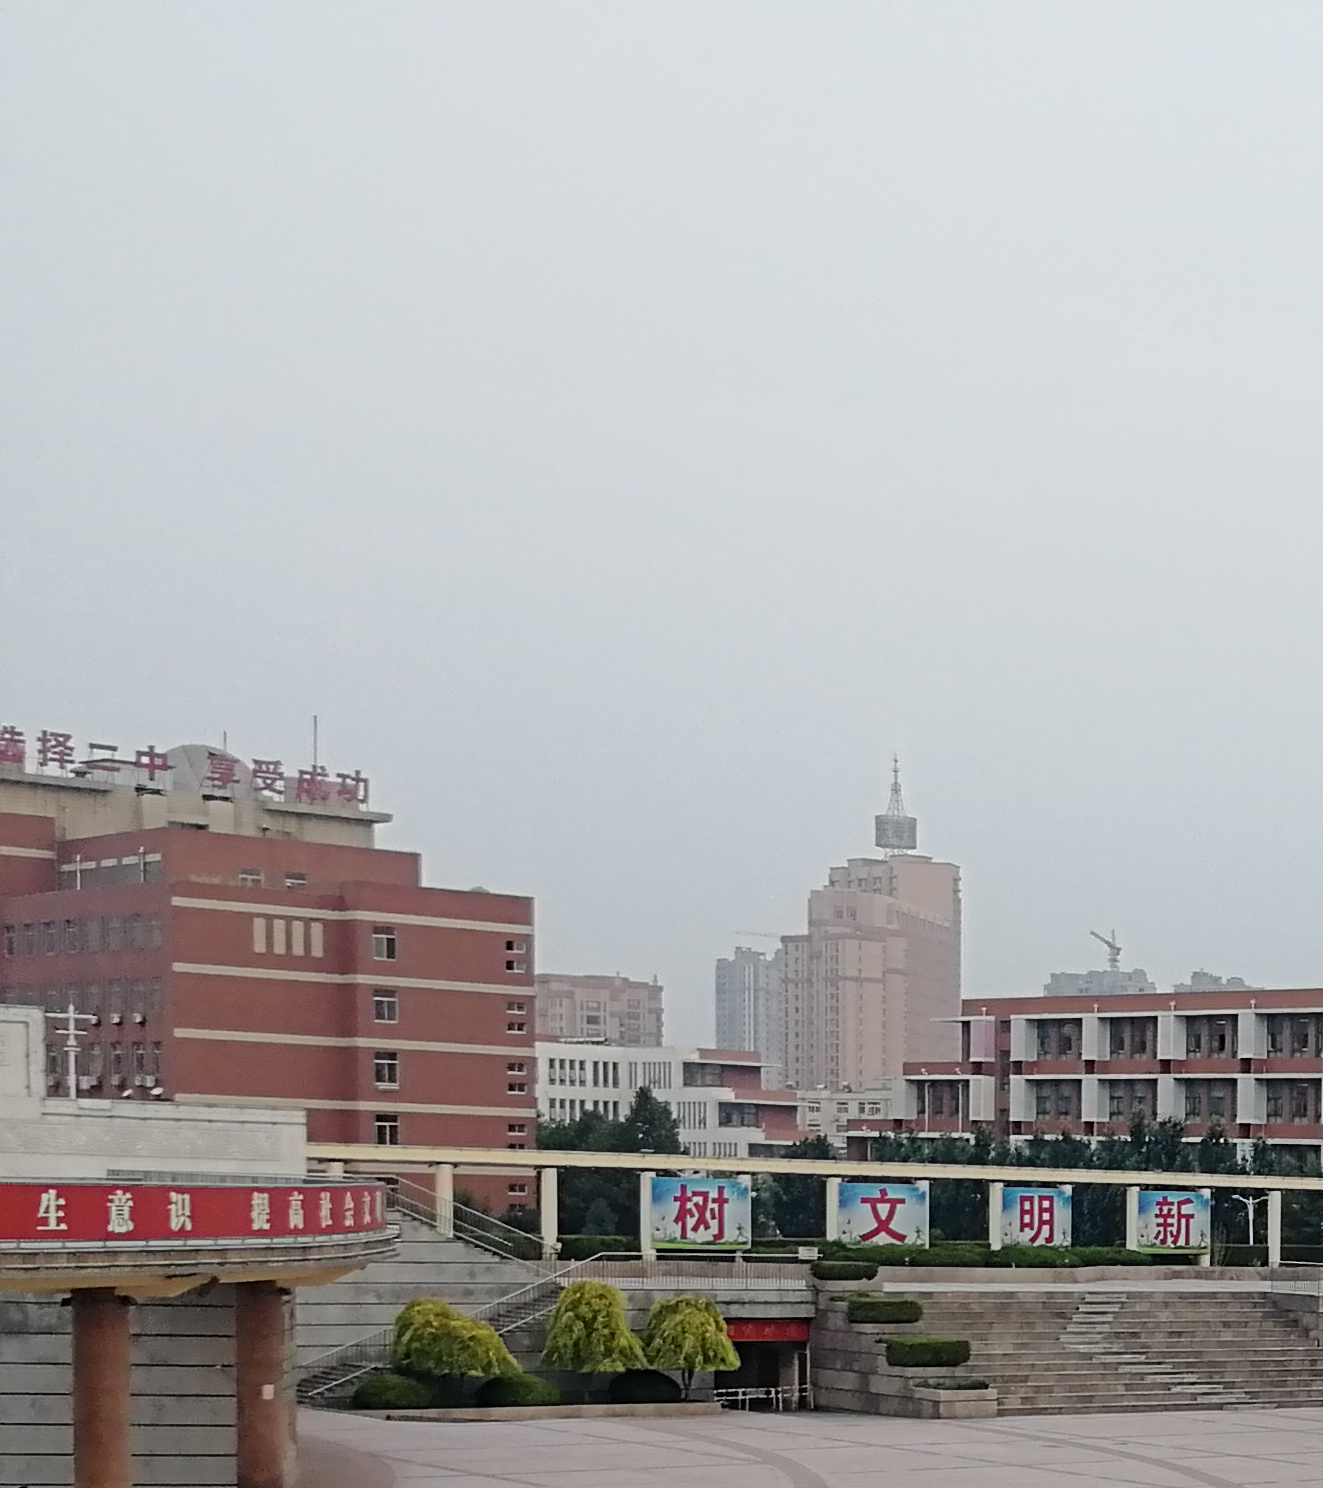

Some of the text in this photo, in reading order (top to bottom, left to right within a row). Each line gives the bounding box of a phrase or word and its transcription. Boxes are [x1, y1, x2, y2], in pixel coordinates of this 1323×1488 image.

[206, 751, 369, 804] 享受成功
[36, 1189, 193, 1234] 生意识
[673, 1184, 730, 1241] 树
[858, 1188, 908, 1243] 文
[1019, 1195, 1055, 1244] 明
[1154, 1196, 1195, 1246] 新
